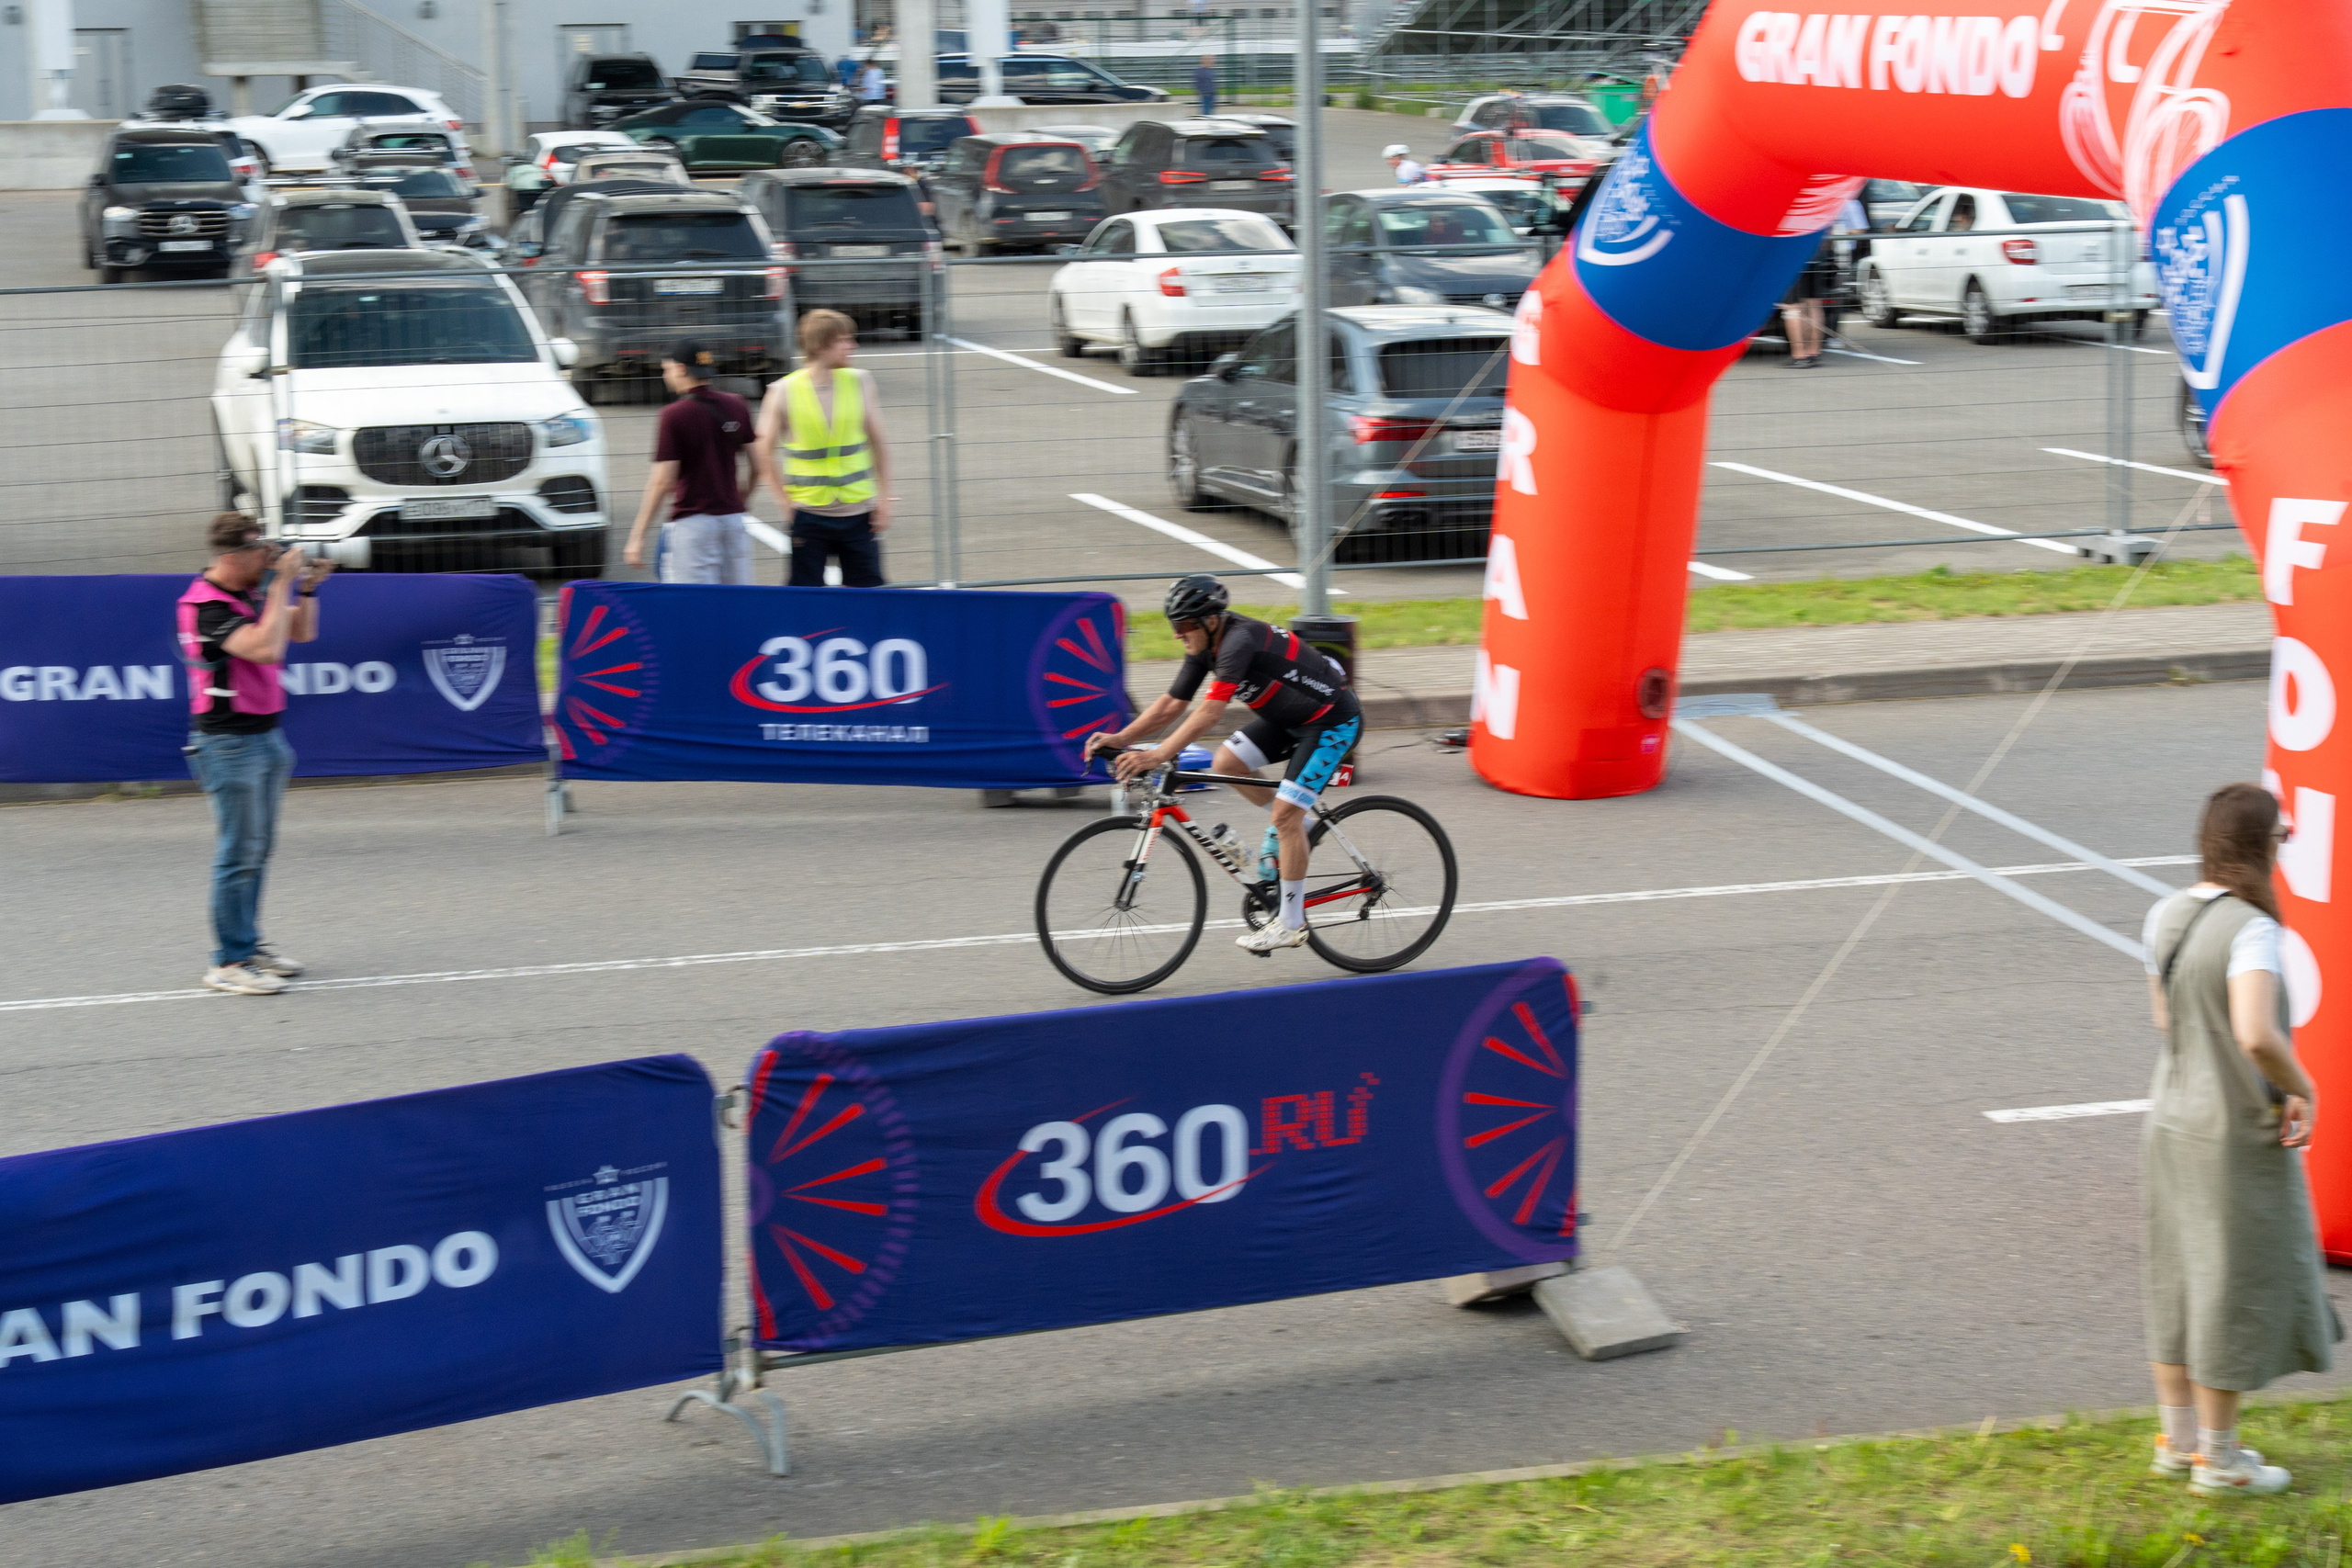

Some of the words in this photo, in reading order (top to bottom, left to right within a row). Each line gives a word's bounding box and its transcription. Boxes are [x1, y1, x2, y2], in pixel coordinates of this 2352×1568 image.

[1735, 11, 1871, 88] GRAN
[1869, 16, 2039, 97] FONDO
[0, 665, 175, 701] GRAN
[277, 660, 397, 695] NDO
[756, 636, 928, 705] 360
[758, 723, 929, 743] ТЕЛЕКАНАЛ
[172, 1230, 499, 1340] FONDO
